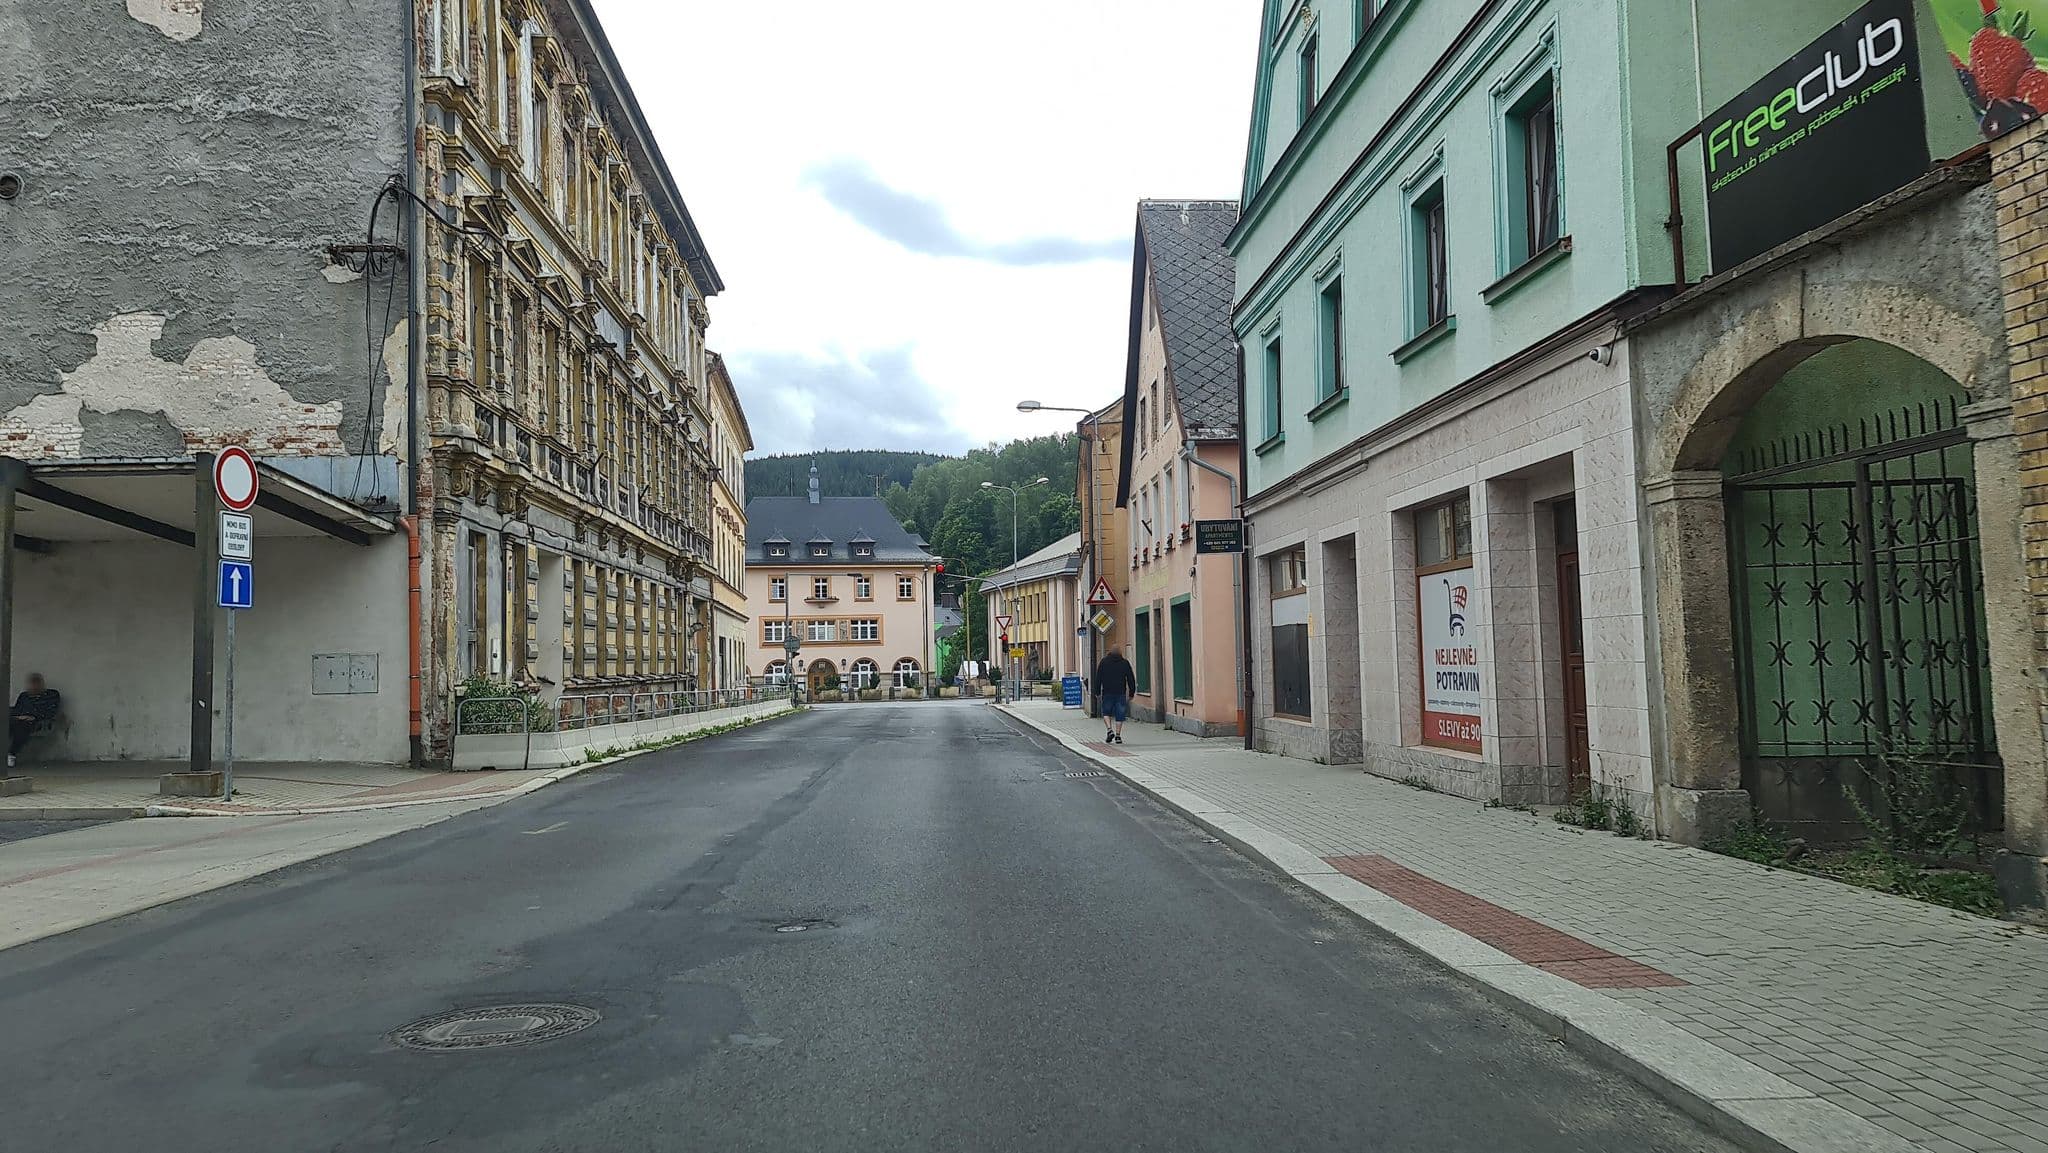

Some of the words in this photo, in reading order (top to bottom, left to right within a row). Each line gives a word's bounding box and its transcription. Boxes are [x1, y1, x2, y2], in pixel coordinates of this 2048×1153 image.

[1435, 645, 1477, 666] NEJLEVNĚJ
[1436, 671, 1480, 692] POTRAVIN
[1438, 719, 1461, 738] SLEVY
[1460, 722, 1470, 740] až
